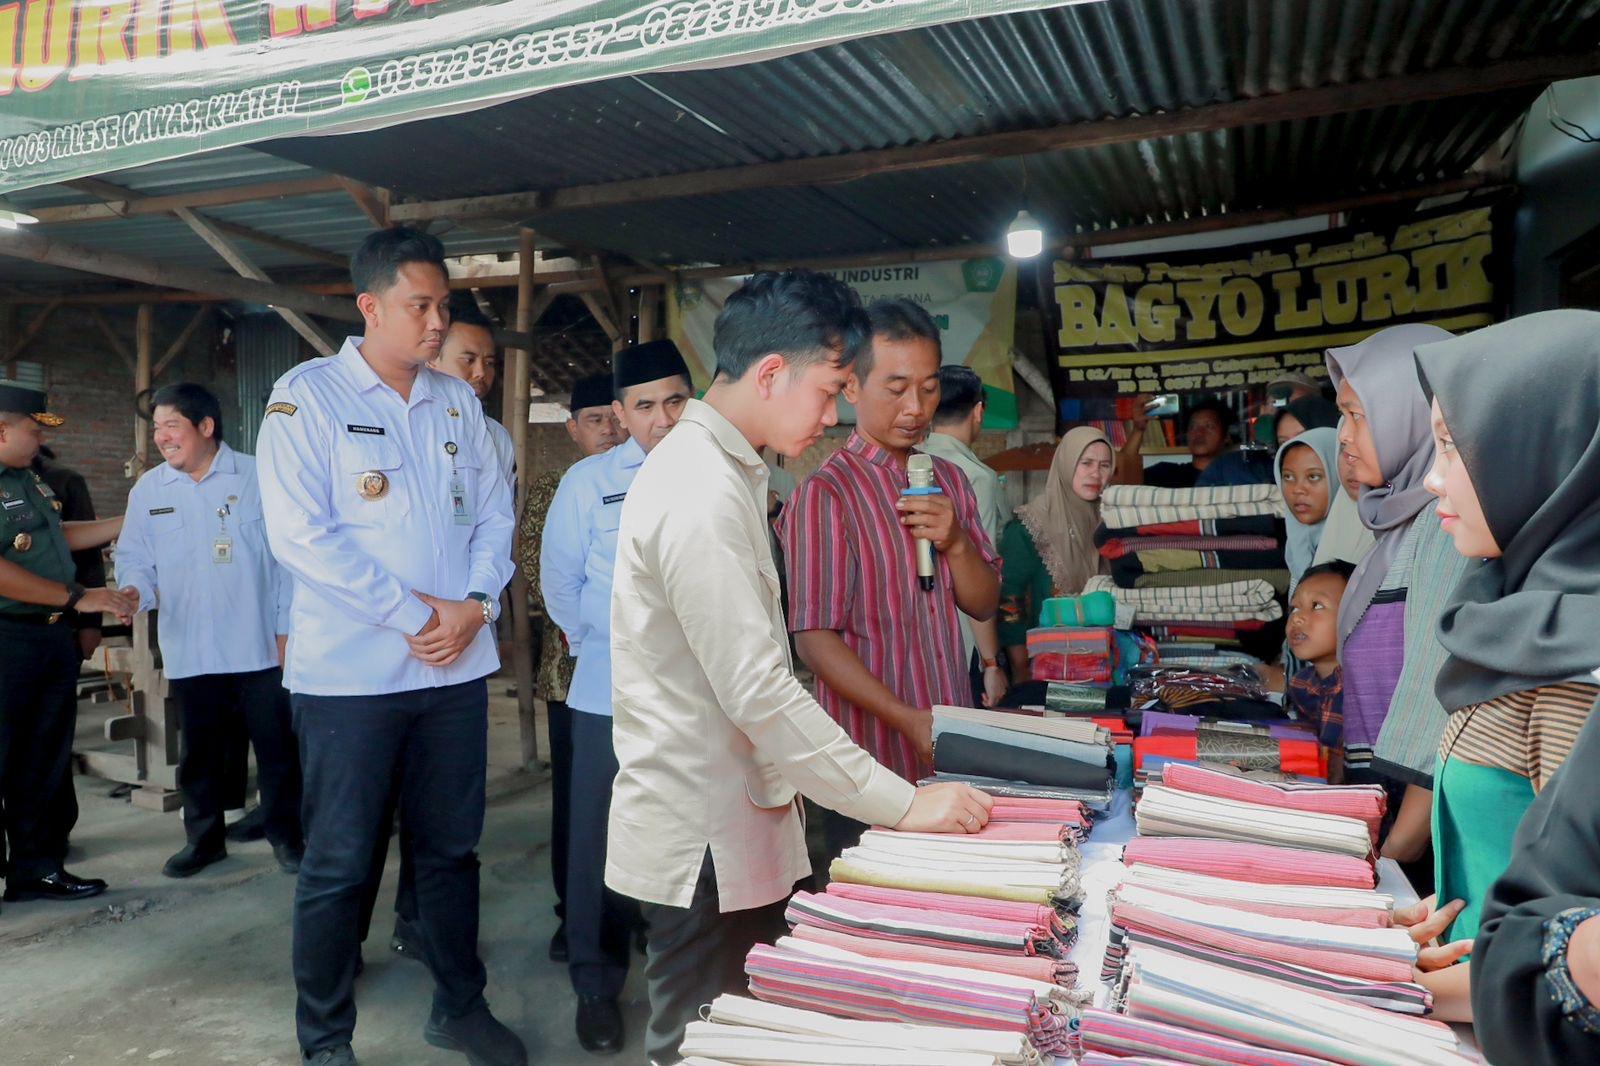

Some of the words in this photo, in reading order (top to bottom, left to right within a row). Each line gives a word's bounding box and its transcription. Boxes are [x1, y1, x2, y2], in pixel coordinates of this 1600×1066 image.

[13, 131, 50, 167] 003
[52, 115, 120, 159] MLESE
[206, 81, 301, 130] KLATEN
[841, 267, 920, 284] INDUSTRI
[1058, 276, 1265, 348] BAGYO
[1272, 234, 1493, 332] LURIK
